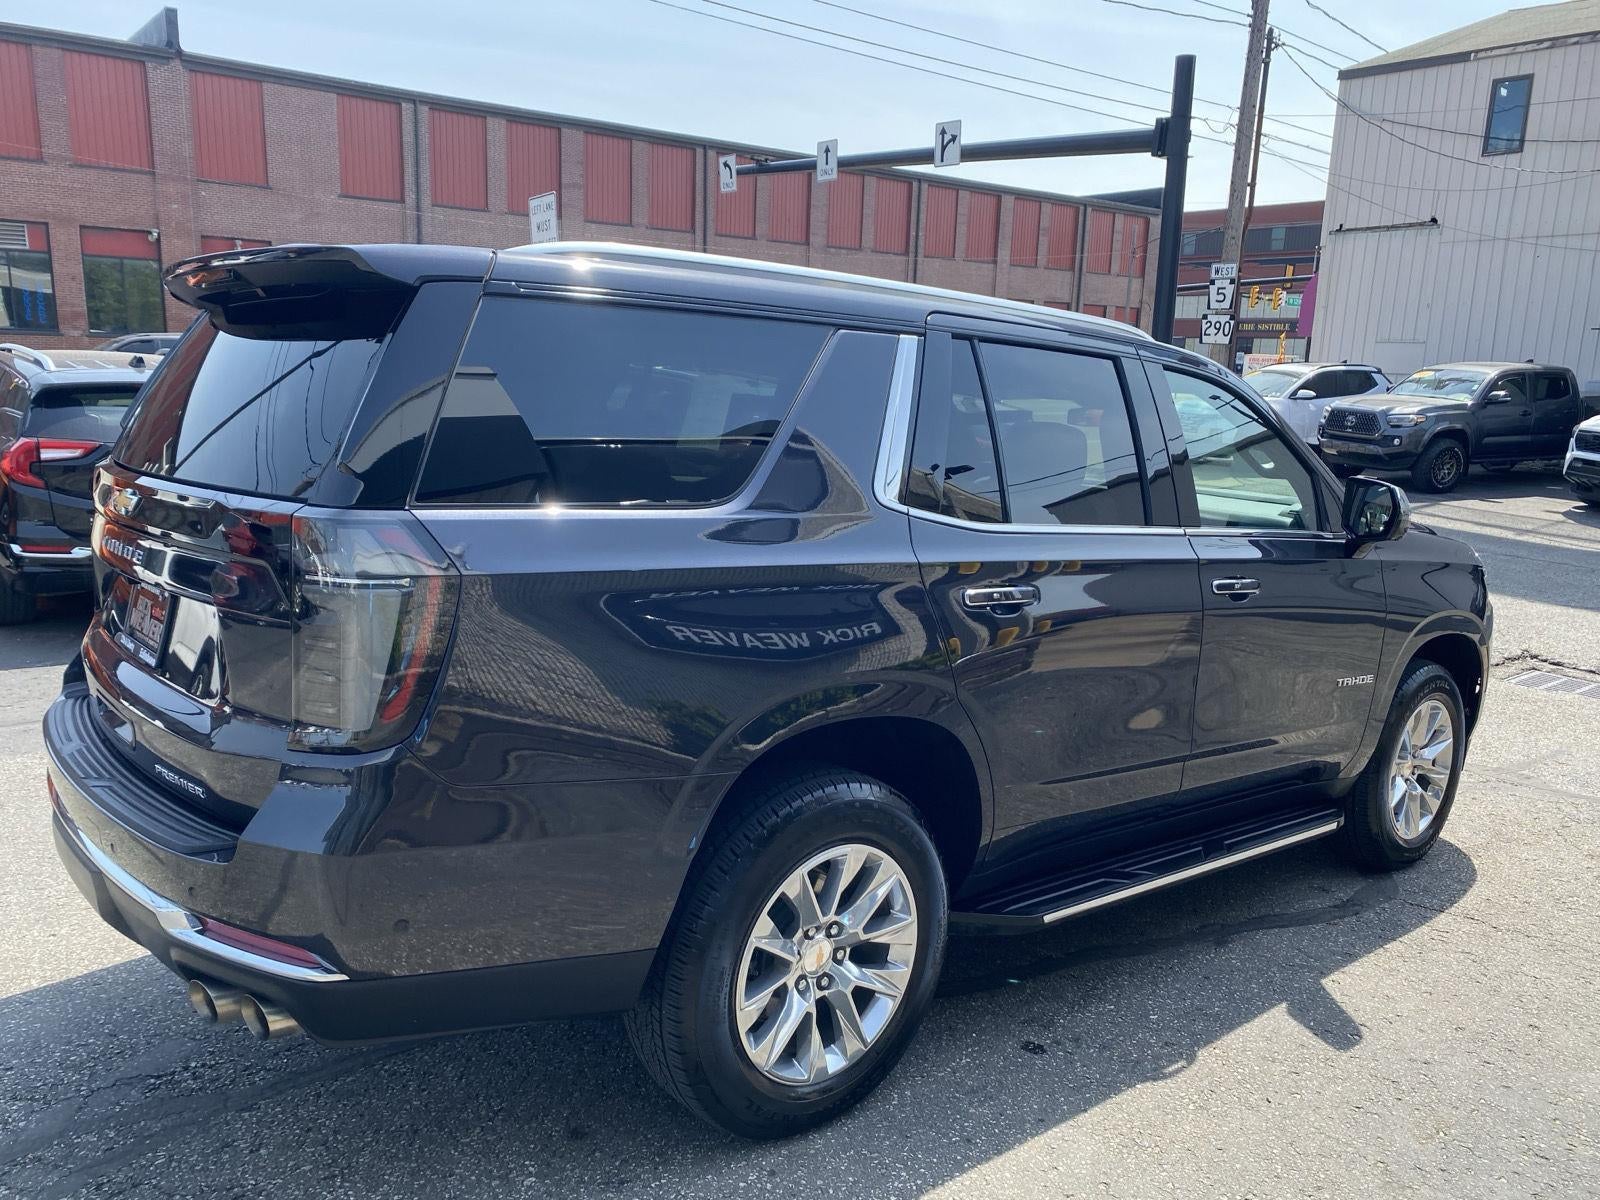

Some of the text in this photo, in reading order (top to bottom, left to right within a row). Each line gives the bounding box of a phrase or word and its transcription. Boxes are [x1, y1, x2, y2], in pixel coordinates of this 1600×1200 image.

[820, 167, 834, 177] ONLY
[722, 181, 734, 190] ONLY
[532, 201, 554, 216] LEFT LANE
[536, 218, 551, 233] MUST
[1214, 266, 1235, 277] WEST
[1215, 286, 1227, 303] 5
[1203, 321, 1232, 338] 290
[1238, 323, 1291, 331] ERIE SISTIBLE
[1336, 674, 1375, 687] TAHOE
[154, 764, 206, 799] PREMIER
